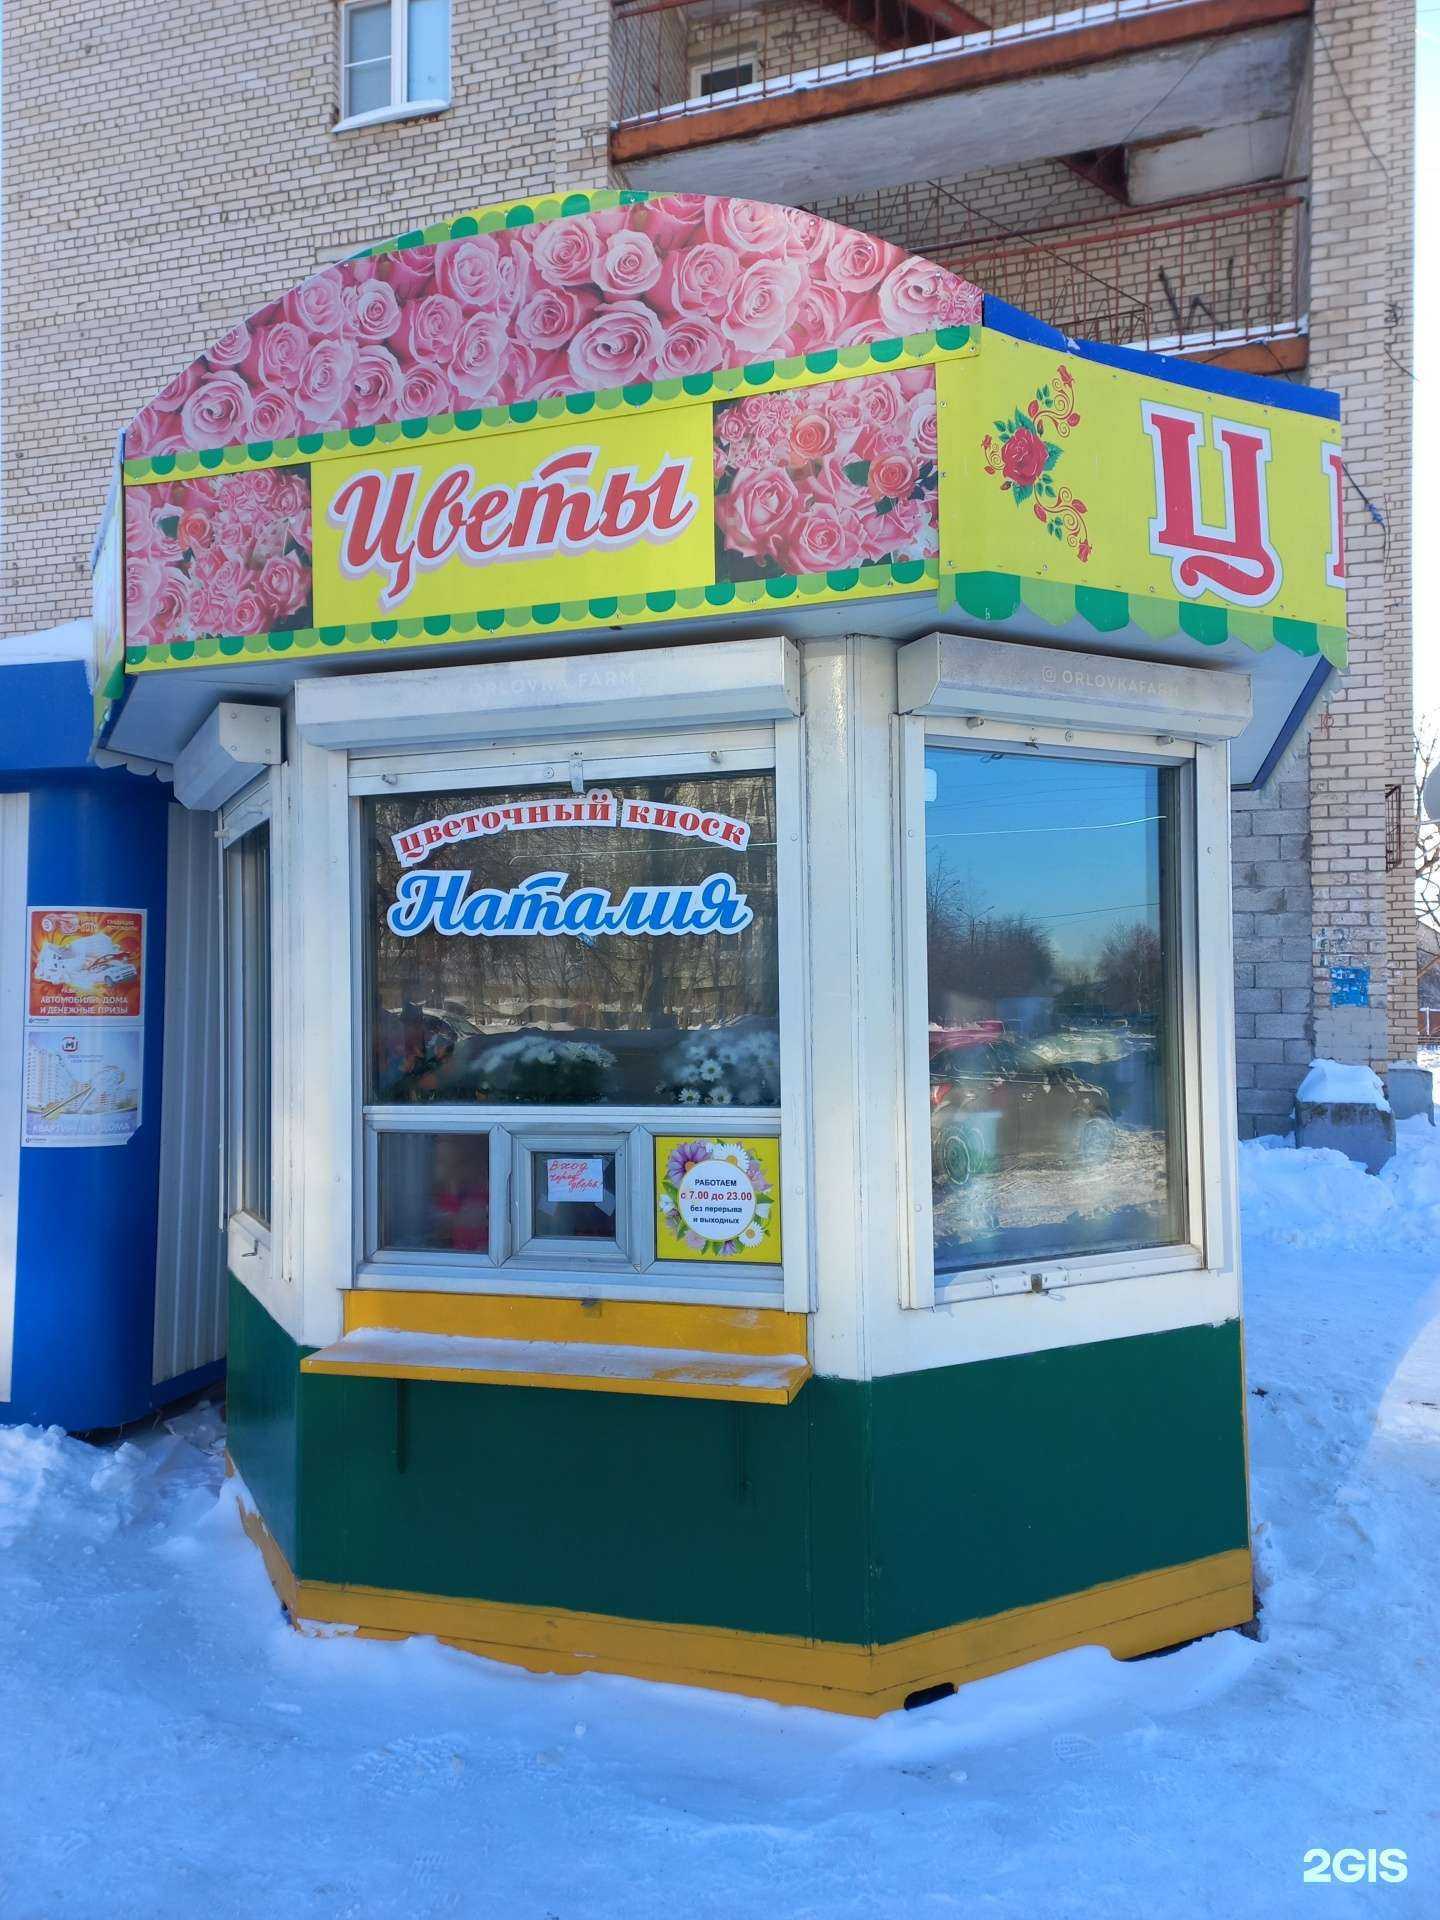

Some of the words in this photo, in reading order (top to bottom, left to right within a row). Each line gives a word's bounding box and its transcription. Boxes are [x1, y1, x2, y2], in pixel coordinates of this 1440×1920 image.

[331, 448, 697, 602] Цветы
[389, 873, 749, 933] Наталия
[102, 996, 128, 1004] ДОМА
[40, 1006, 46, 1014] И
[98, 1006, 128, 1014] ПРИЗЫ
[694, 1179, 737, 1187] РАБОТАЕМ
[680, 1192, 686, 1200] с
[689, 1190, 709, 1200] 7.00
[711, 1193, 724, 1201] до
[726, 1191, 752, 1201] 23.00
[690, 1204, 703, 1212] без
[704, 1206, 743, 1214] перерыва
[699, 1217, 740, 1225] выходных
